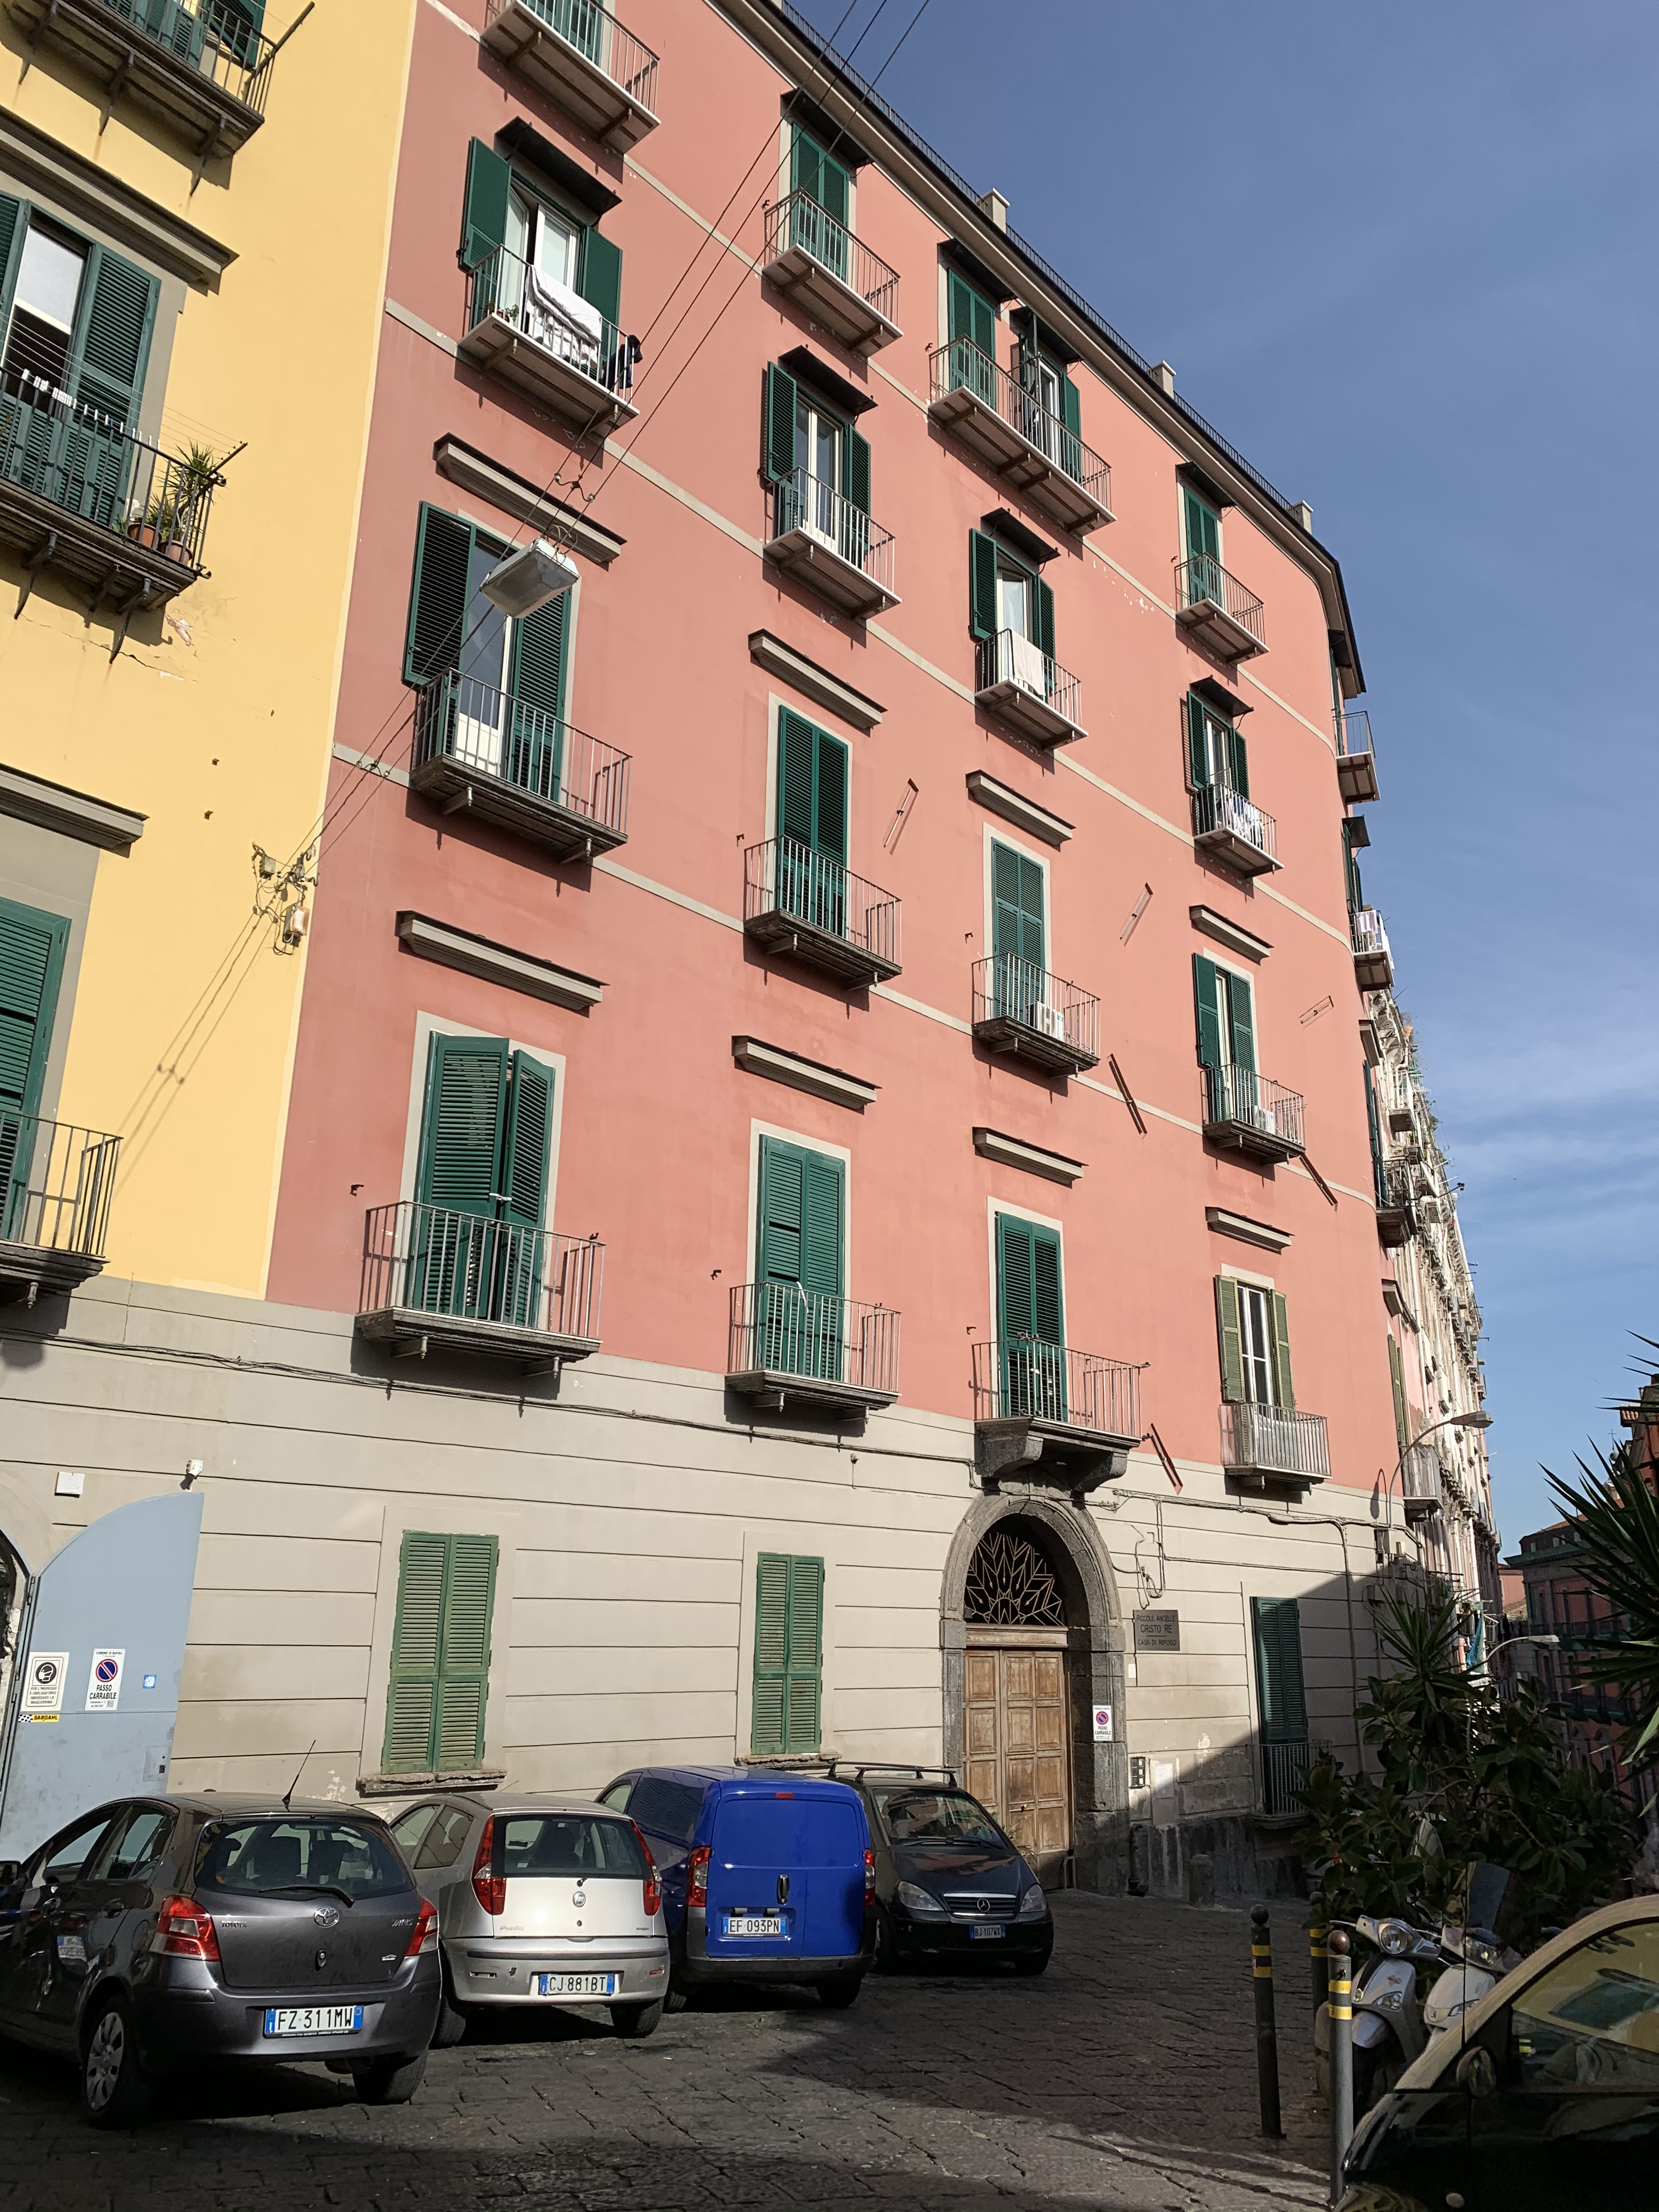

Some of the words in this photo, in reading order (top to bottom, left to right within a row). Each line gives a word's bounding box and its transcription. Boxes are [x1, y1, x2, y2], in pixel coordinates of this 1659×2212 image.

[1141, 1624, 1161, 1633] CRISTO
[1164, 1624, 1172, 1633] RE
[730, 1920, 743, 1932] EF
[747, 1920, 779, 1932] 093PN
[975, 1927, 982, 1937] BJ
[549, 1977, 563, 1991] CJ
[567, 1977, 606, 1991] 881BT
[278, 2010, 298, 2030] FZ
[303, 2007, 353, 2029] 311MW
